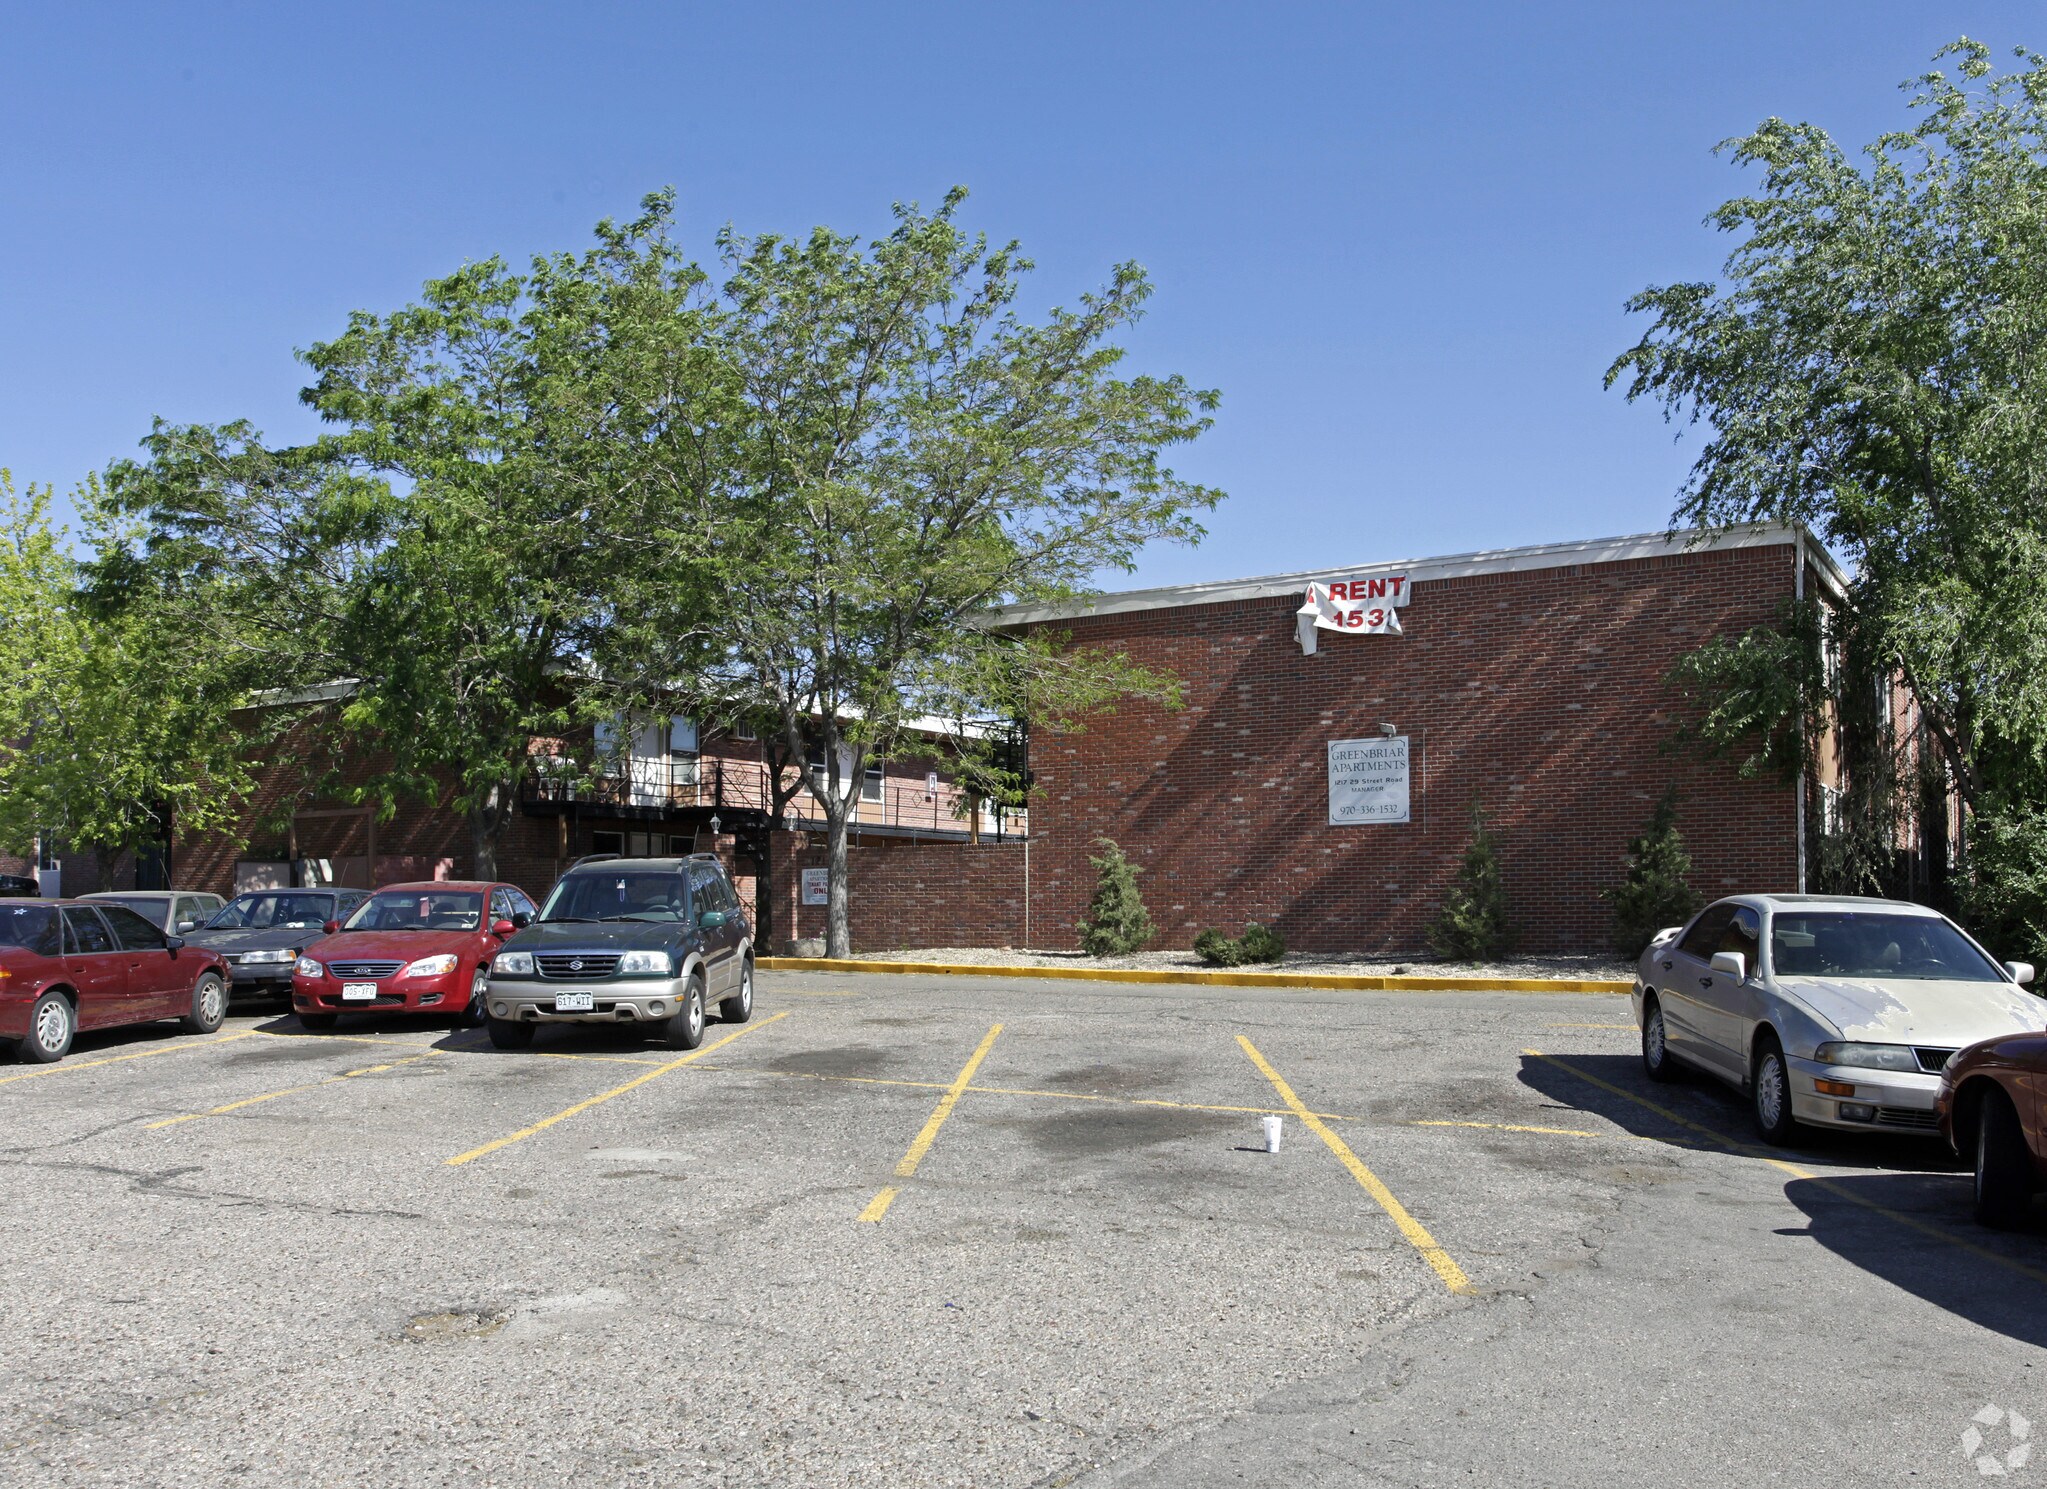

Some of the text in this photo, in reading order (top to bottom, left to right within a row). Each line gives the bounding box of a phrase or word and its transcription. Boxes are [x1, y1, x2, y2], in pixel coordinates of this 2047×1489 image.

[1328, 575, 1406, 601] RENT
[1333, 609, 1392, 628] 153
[1331, 747, 1405, 761] GREENBRIAR
[1331, 760, 1406, 773] APARTMENTS
[1340, 804, 1398, 815] 970-336-1532
